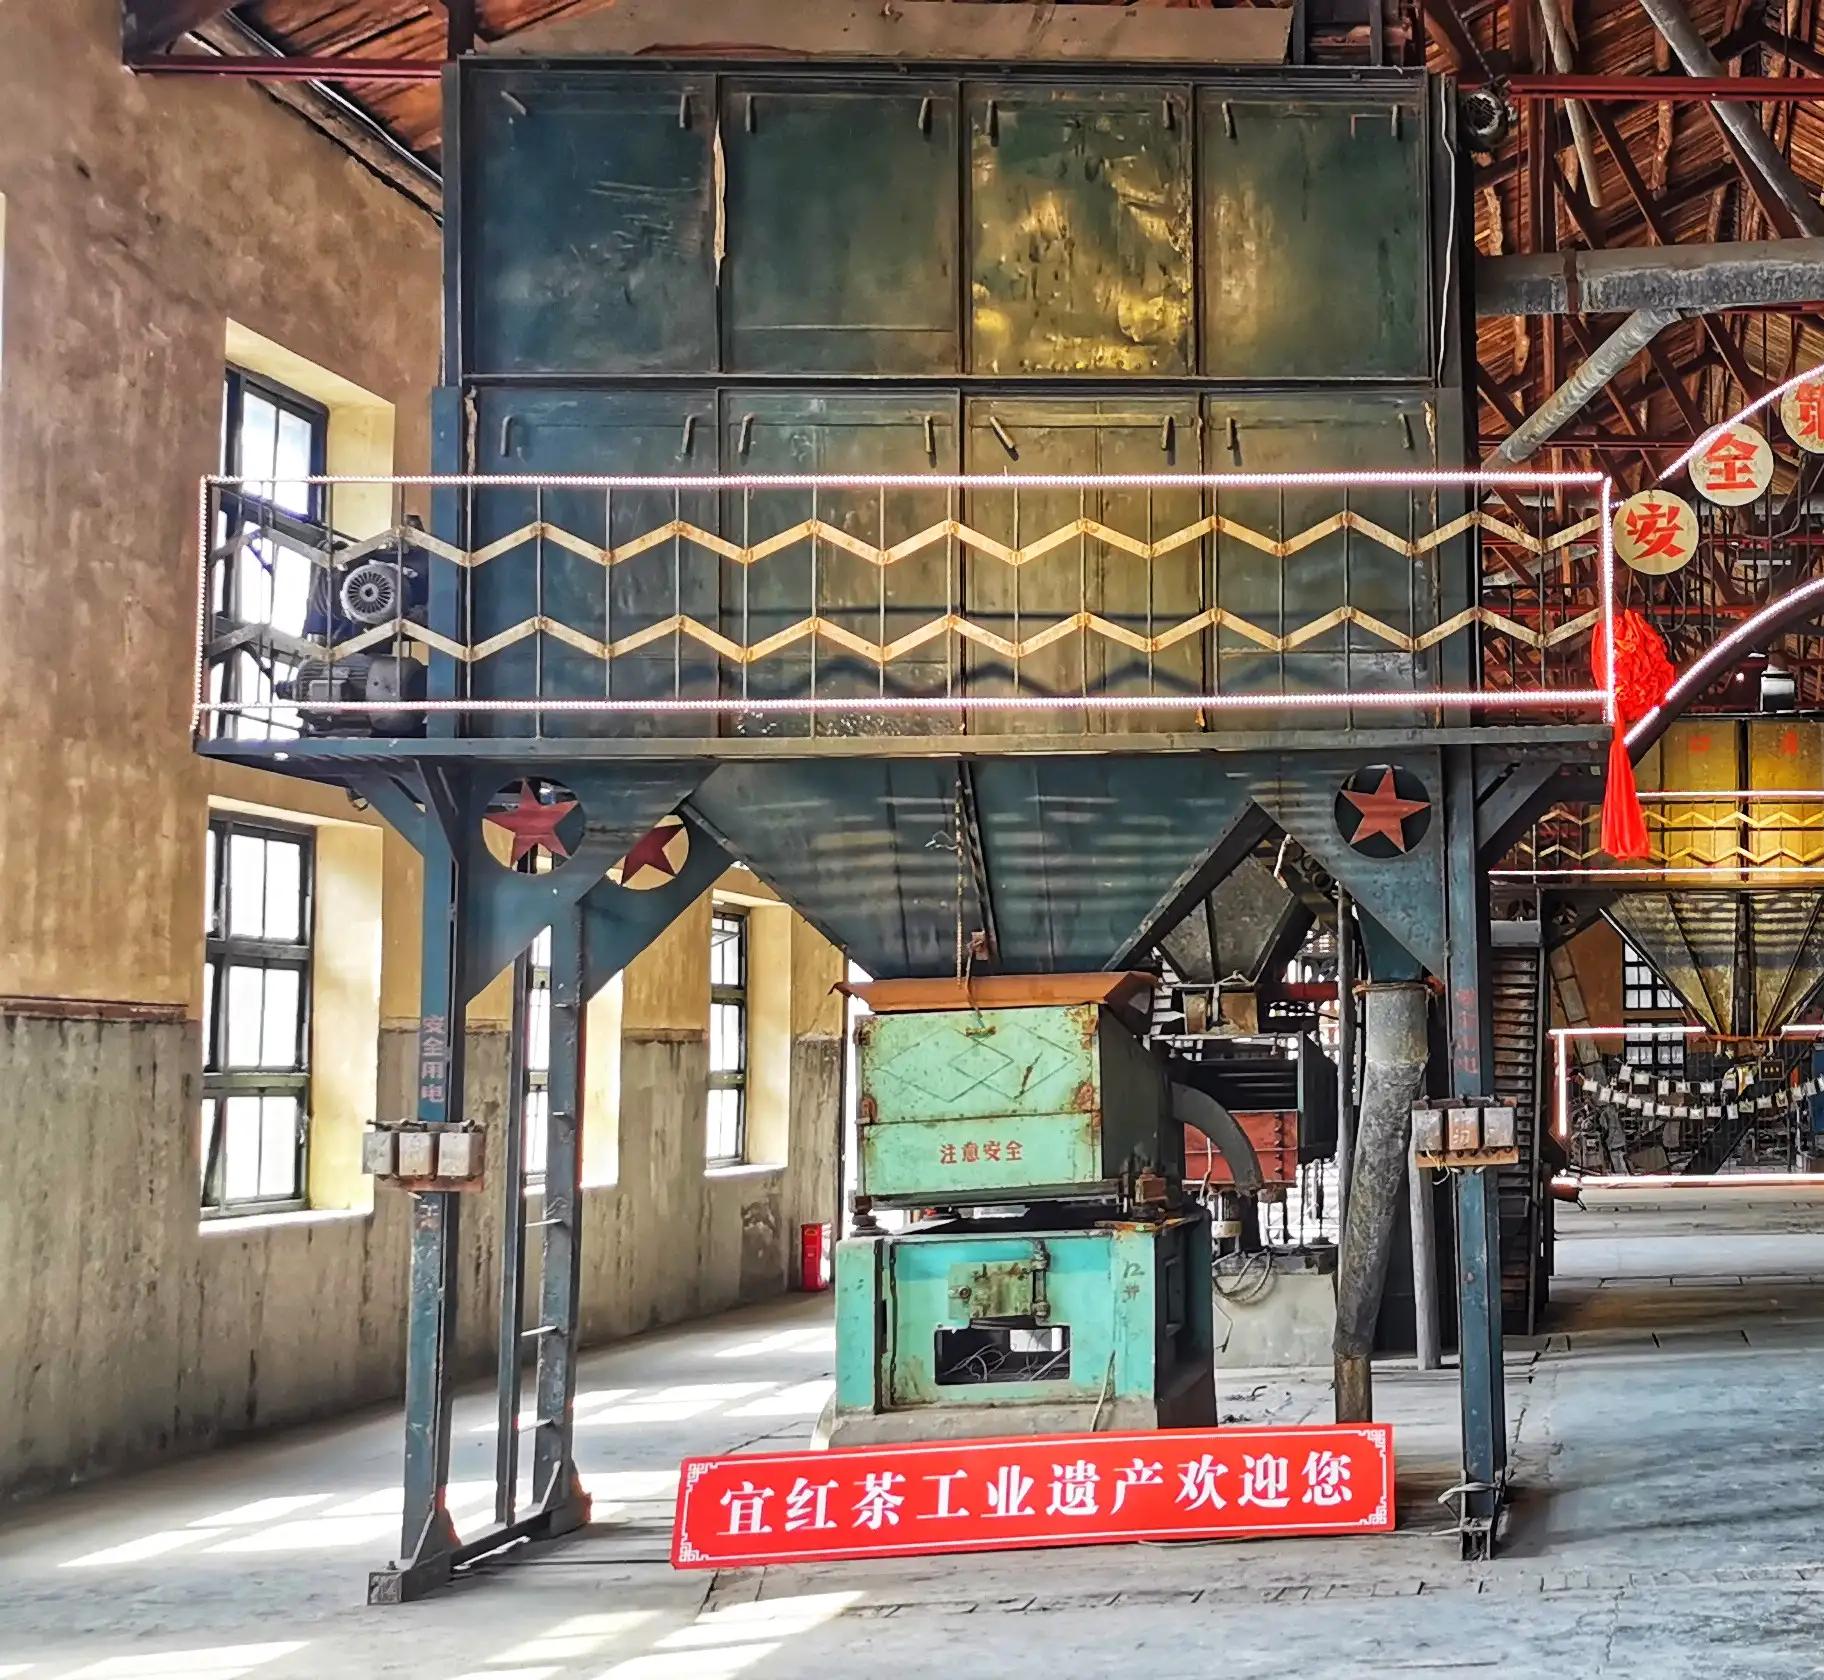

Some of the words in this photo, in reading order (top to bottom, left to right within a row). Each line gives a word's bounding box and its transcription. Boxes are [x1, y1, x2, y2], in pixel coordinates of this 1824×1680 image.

[420, 1014, 447, 1103] 安全用电
[940, 1139, 1024, 1165] 注意安全
[716, 1449, 1354, 1537] 宜红茶工业遗产欢迎您
